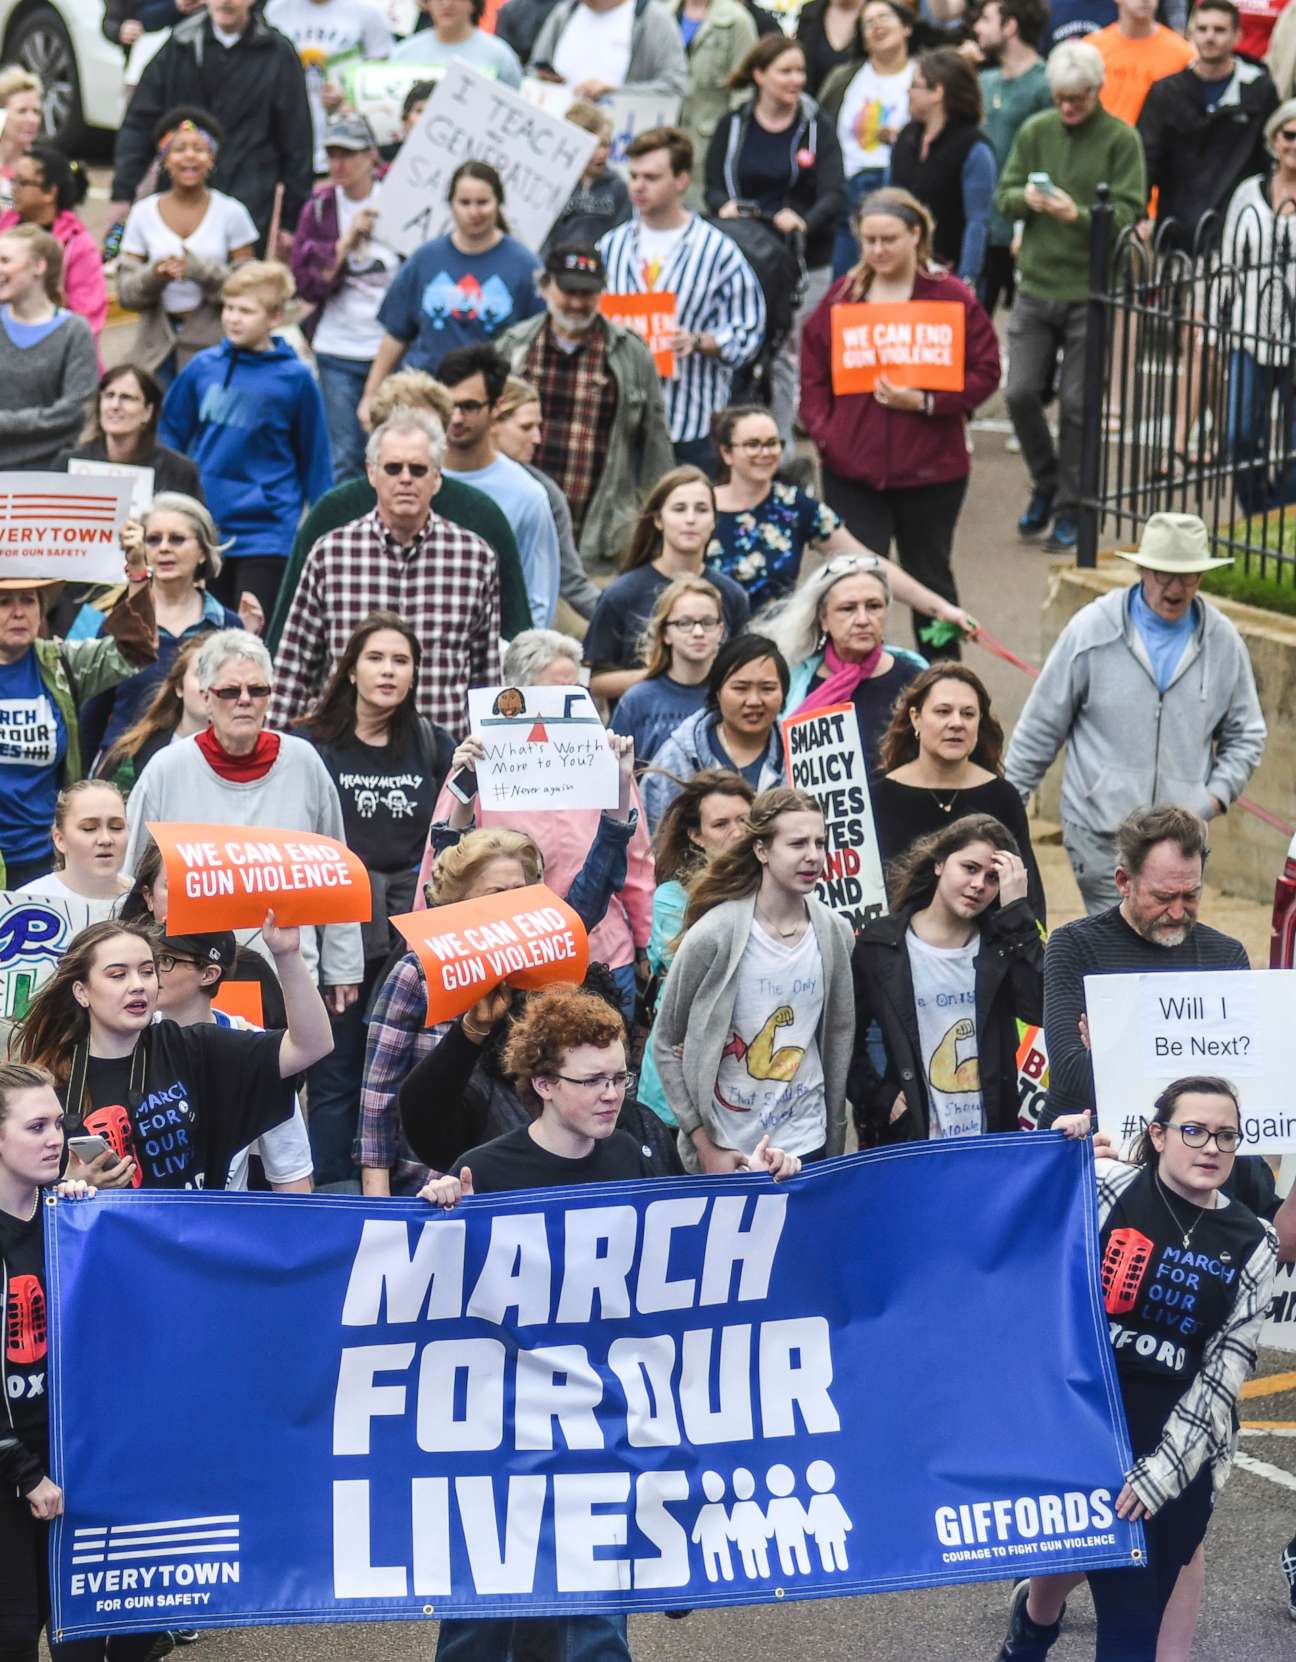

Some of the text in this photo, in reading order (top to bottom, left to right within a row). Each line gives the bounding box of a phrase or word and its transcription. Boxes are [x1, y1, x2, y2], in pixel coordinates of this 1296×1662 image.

[487, 93, 580, 170] TEACH
[842, 323, 953, 346] WE CAN END
[843, 346, 953, 368] GUN VIOLENCE
[0, 549, 88, 558] FOR GUN SAFETY
[9, 724, 50, 743] OUR
[790, 714, 845, 756] SMART
[484, 738, 604, 761] What's Worth
[491, 753, 595, 776] More to You?
[792, 750, 856, 788] POLICY
[493, 782, 575, 801] #Never again
[176, 842, 342, 868] WE CAN END
[185, 862, 353, 899] GUN VIOLENCE
[815, 876, 863, 908] 2ND
[423, 907, 567, 962] WE CAN END
[441, 931, 577, 992] GUN VIOLENCE
[757, 977, 784, 996] The
[1158, 996, 1228, 1020] Will I
[1155, 1035, 1251, 1057] Be Next?
[138, 1109, 182, 1137] FOR
[1241, 1112, 1296, 1144] gain
[145, 1129, 189, 1157] OUR
[153, 1151, 191, 1178] LIV
[341, 1192, 790, 1327] MARCH
[1162, 1246, 1236, 1285] MARCH
[1156, 1262, 1200, 1291] FOR
[1148, 1283, 1198, 1314] OUR
[332, 1316, 841, 1456] FOR OUR
[934, 1488, 1115, 1547] GIFFORDS
[332, 1470, 691, 1599] LIVES
[942, 1533, 1116, 1564] COURAGE TO FIGHT GUN VIOLENCE
[71, 1562, 240, 1596] EVERYTOWN
[96, 1593, 211, 1612] FOR GUN SAFETY
